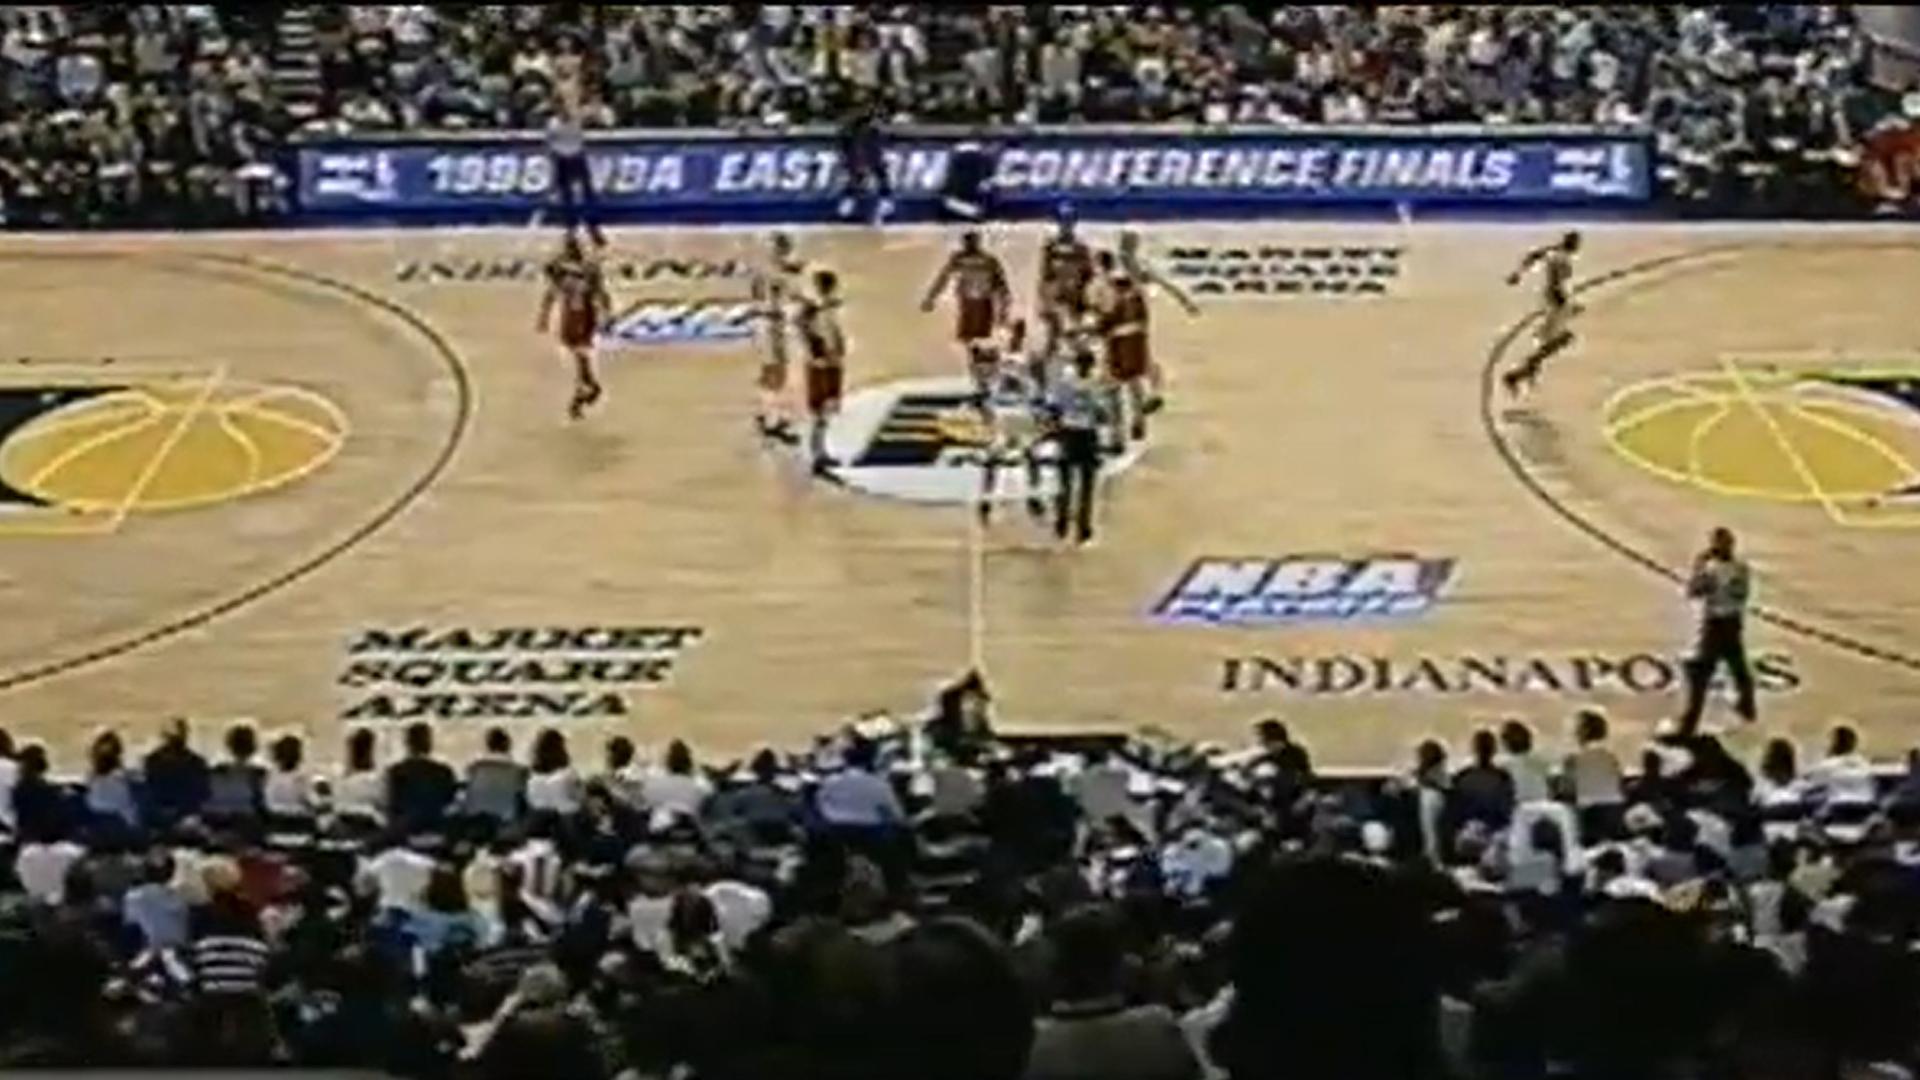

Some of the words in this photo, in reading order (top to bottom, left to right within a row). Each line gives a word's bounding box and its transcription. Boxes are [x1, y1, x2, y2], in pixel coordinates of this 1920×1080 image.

[427, 153, 549, 193] 1998
[715, 151, 951, 191] EASTN
[993, 148, 1326, 190] CONFERENCE
[1332, 149, 1516, 190] FINALS
[1176, 556, 1424, 599] NBA
[348, 626, 703, 654] MARKET
[338, 659, 674, 688] SQUARE
[1219, 654, 1800, 693] INDIANAPOS
[338, 693, 629, 719] ARENA
